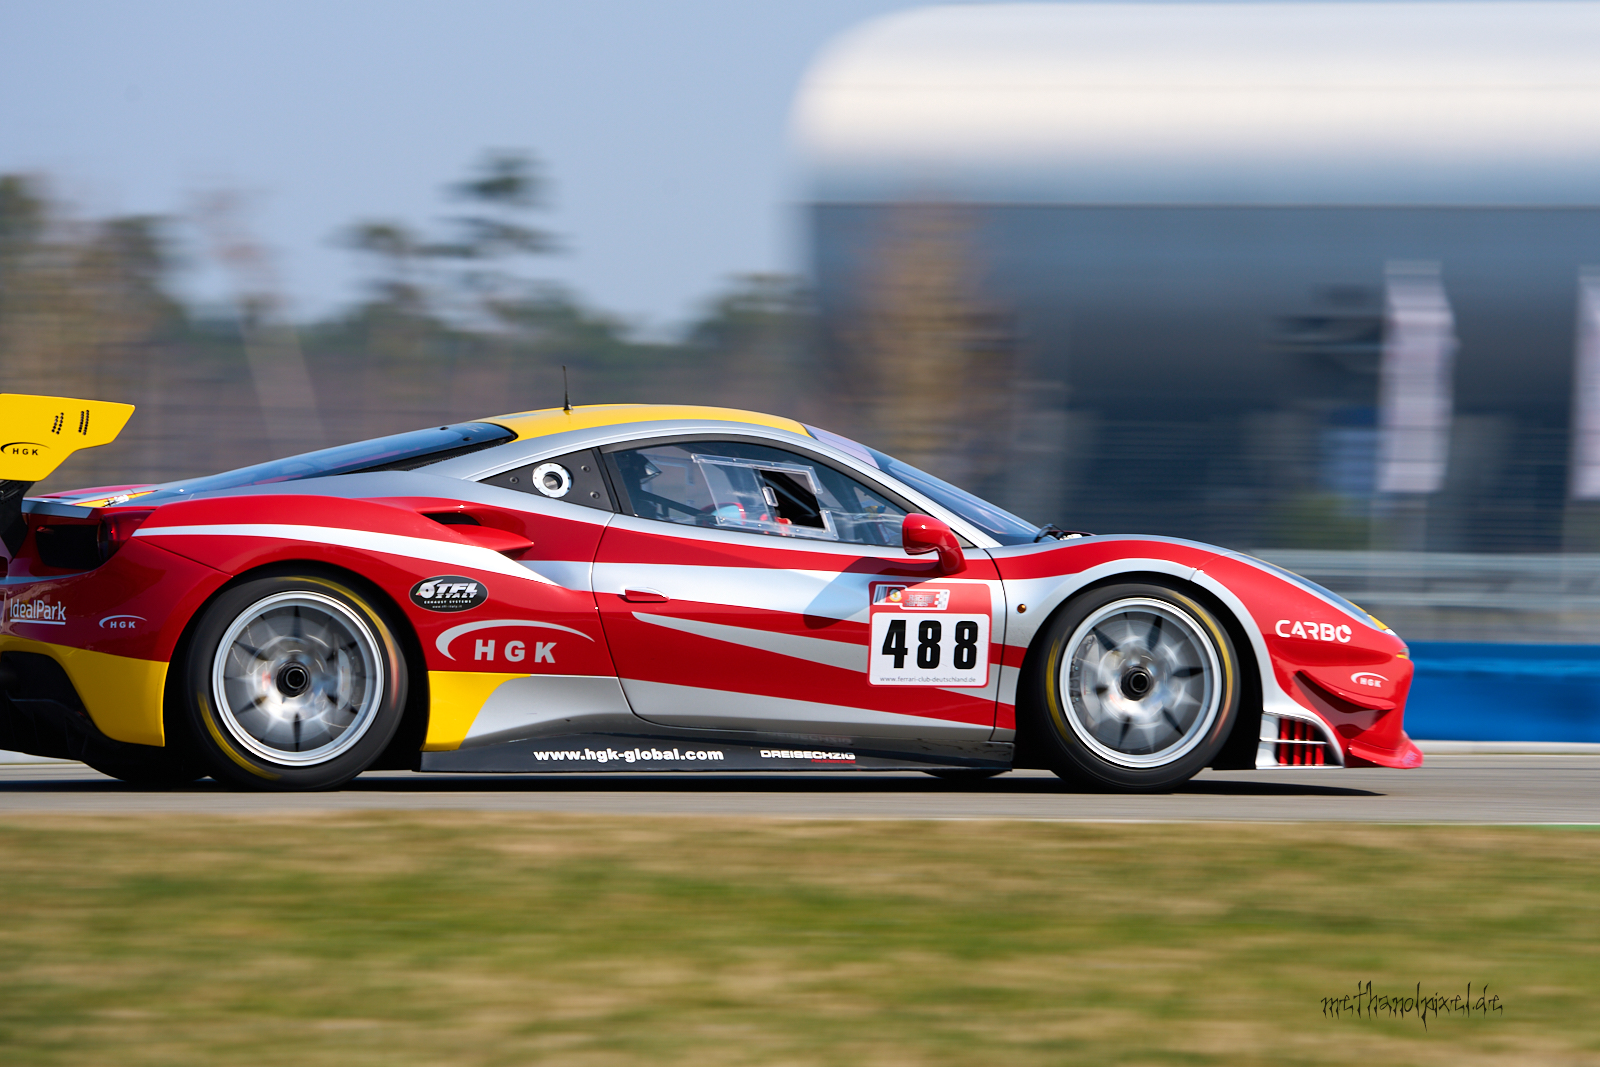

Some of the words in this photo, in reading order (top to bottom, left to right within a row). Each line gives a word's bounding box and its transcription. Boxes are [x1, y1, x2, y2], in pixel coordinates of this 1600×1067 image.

[12, 447, 39, 456] HGK
[10, 598, 67, 621] IdealPark
[109, 620, 136, 629] HGK
[881, 619, 979, 670] 488
[474, 639, 558, 664] HGK
[879, 675, 977, 684] www.ferrari-club-deutschland.de
[1360, 677, 1382, 688] HGK
[533, 748, 724, 763] www.hgk-global.com
[760, 750, 856, 760] DREISECHZIG
